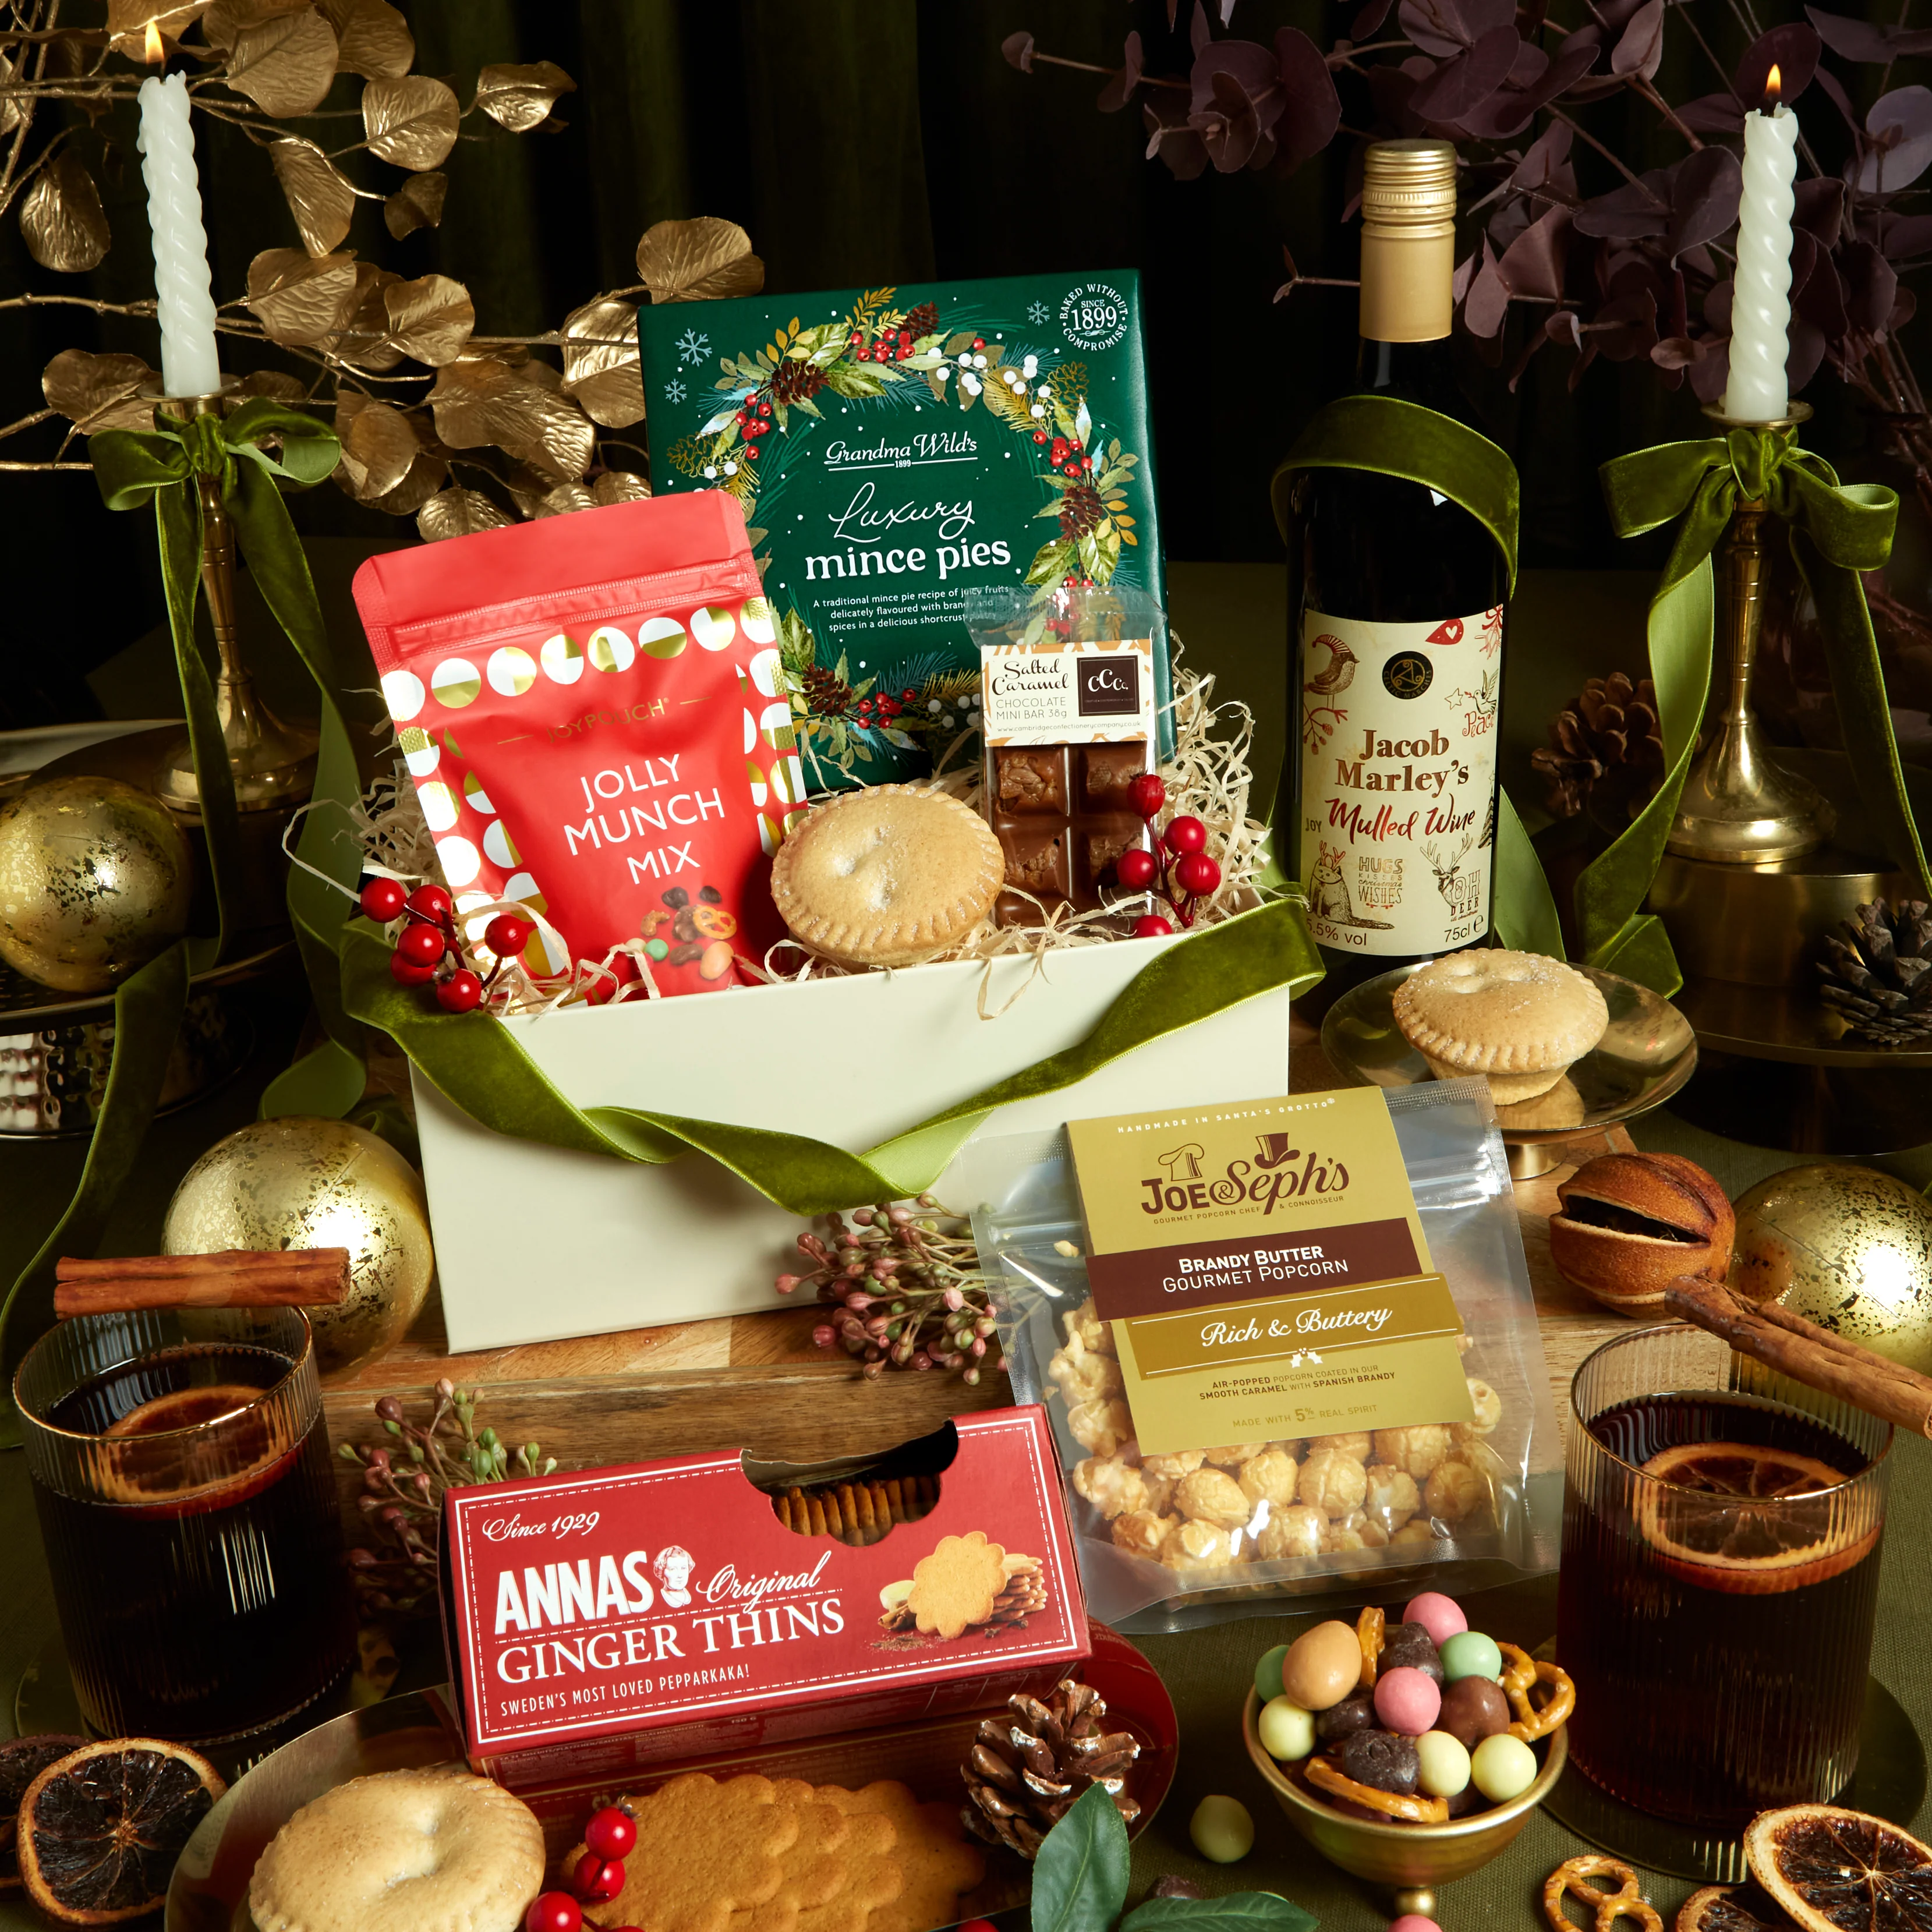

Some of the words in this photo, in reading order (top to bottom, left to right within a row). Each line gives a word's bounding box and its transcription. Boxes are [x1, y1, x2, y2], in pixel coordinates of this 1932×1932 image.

[1060, 288, 1083, 319] BAKED
[1087, 284, 1128, 315] WITHOUT
[1081, 299, 1105, 308] SINCE
[1071, 306, 1117, 330] 1899
[1063, 324, 1127, 351] COMPROMISE
[823, 437, 911, 465] Grandma
[913, 431, 978, 457] Wild's
[895, 459, 912, 468] 1899
[828, 482, 975, 543] Luxury
[805, 547, 926, 580] mince
[936, 537, 1011, 580] pies
[813, 600, 820, 608] A
[822, 595, 869, 607] traditional
[872, 595, 898, 603] mince
[901, 593, 915, 603] pie
[918, 590, 946, 600] recipe
[949, 588, 958, 597] of
[961, 587, 982, 598] juicy
[985, 585, 1009, 594] fruits
[830, 607, 873, 618] delicately
[876, 604, 918, 615] flavoured
[921, 602, 940, 611] with
[829, 622, 856, 633] spices
[877, 618, 918, 627] delicious
[921, 614, 966, 624] shortcrust
[1003, 658, 1060, 680] Salted
[992, 673, 1069, 695] Caramel
[996, 696, 1066, 709] CHOCOLATE
[996, 710, 1020, 720] MINI
[1024, 709, 1045, 719] BAR
[1048, 709, 1067, 719] 38g
[1358, 728, 1449, 760] Jacob
[581, 753, 680, 814] JOLLY
[1335, 759, 1469, 798] Marley's
[563, 787, 725, 856] MUNCH
[1305, 817, 1322, 833] JOY
[1325, 798, 1419, 844] Mulled
[1425, 792, 1475, 836] Wine
[627, 840, 700, 884] MIX
[1358, 857, 1403, 874] HUGS
[1358, 872, 1402, 881] KISSES
[1358, 886, 1403, 904] WISHES
[1450, 869, 1480, 904] OH
[1450, 897, 1478, 917] DEER
[1344, 933, 1367, 946] vol
[1444, 923, 1470, 943] 75cl
[1118, 1119, 1187, 1133] HANDMADE
[1195, 1116, 1208, 1124] IN
[1216, 1109, 1271, 1121] SANTA'S
[1141, 1178, 1211, 1215] JOE
[1209, 1152, 1350, 1215] Seph's
[1153, 1214, 1193, 1225] GOURMET
[1197, 1209, 1236, 1220] POPCORN
[1239, 1206, 1261, 1215] CHEF
[1288, 1195, 1344, 1208] CONNOISSEUR
[1178, 1253, 1250, 1274] BRANDY
[1254, 1245, 1325, 1265] BUTTER
[1163, 1270, 1252, 1293] GOURMET
[1258, 1259, 1349, 1282] POPCORN
[1201, 1318, 1264, 1347] Rich
[1268, 1319, 1292, 1337] &
[1296, 1308, 1393, 1333] Buttery
[1199, 1389, 1239, 1400] SMOOTH
[1241, 1384, 1287, 1396] CARAMEL
[1289, 1382, 1311, 1390] WITH
[1312, 1376, 1354, 1388] SPANISH
[1357, 1371, 1396, 1383] BRANDY
[1212, 1377, 1271, 1389] AIR-POPPED
[1273, 1372, 1313, 1383] POPCORN
[1315, 1368, 1347, 1378] COATED
[1361, 1364, 1379, 1373] OUR
[1233, 1417, 1261, 1428] MADE
[1265, 1415, 1291, 1425] WITH
[1319, 1408, 1344, 1418] REAL
[1347, 1404, 1378, 1415] SPIRIT
[482, 1513, 546, 1541] Since
[551, 1512, 600, 1540] 1929
[494, 1551, 654, 1635] ANNAS
[695, 1550, 832, 1613] Original
[496, 1624, 686, 1684] GINGER
[692, 1598, 844, 1653] THINS
[500, 1692, 567, 1717] SWEDEN'S
[572, 1686, 606, 1705] MOST
[613, 1678, 653, 1699] LOVED
[659, 1663, 750, 1691] PEPPARKAKA!
